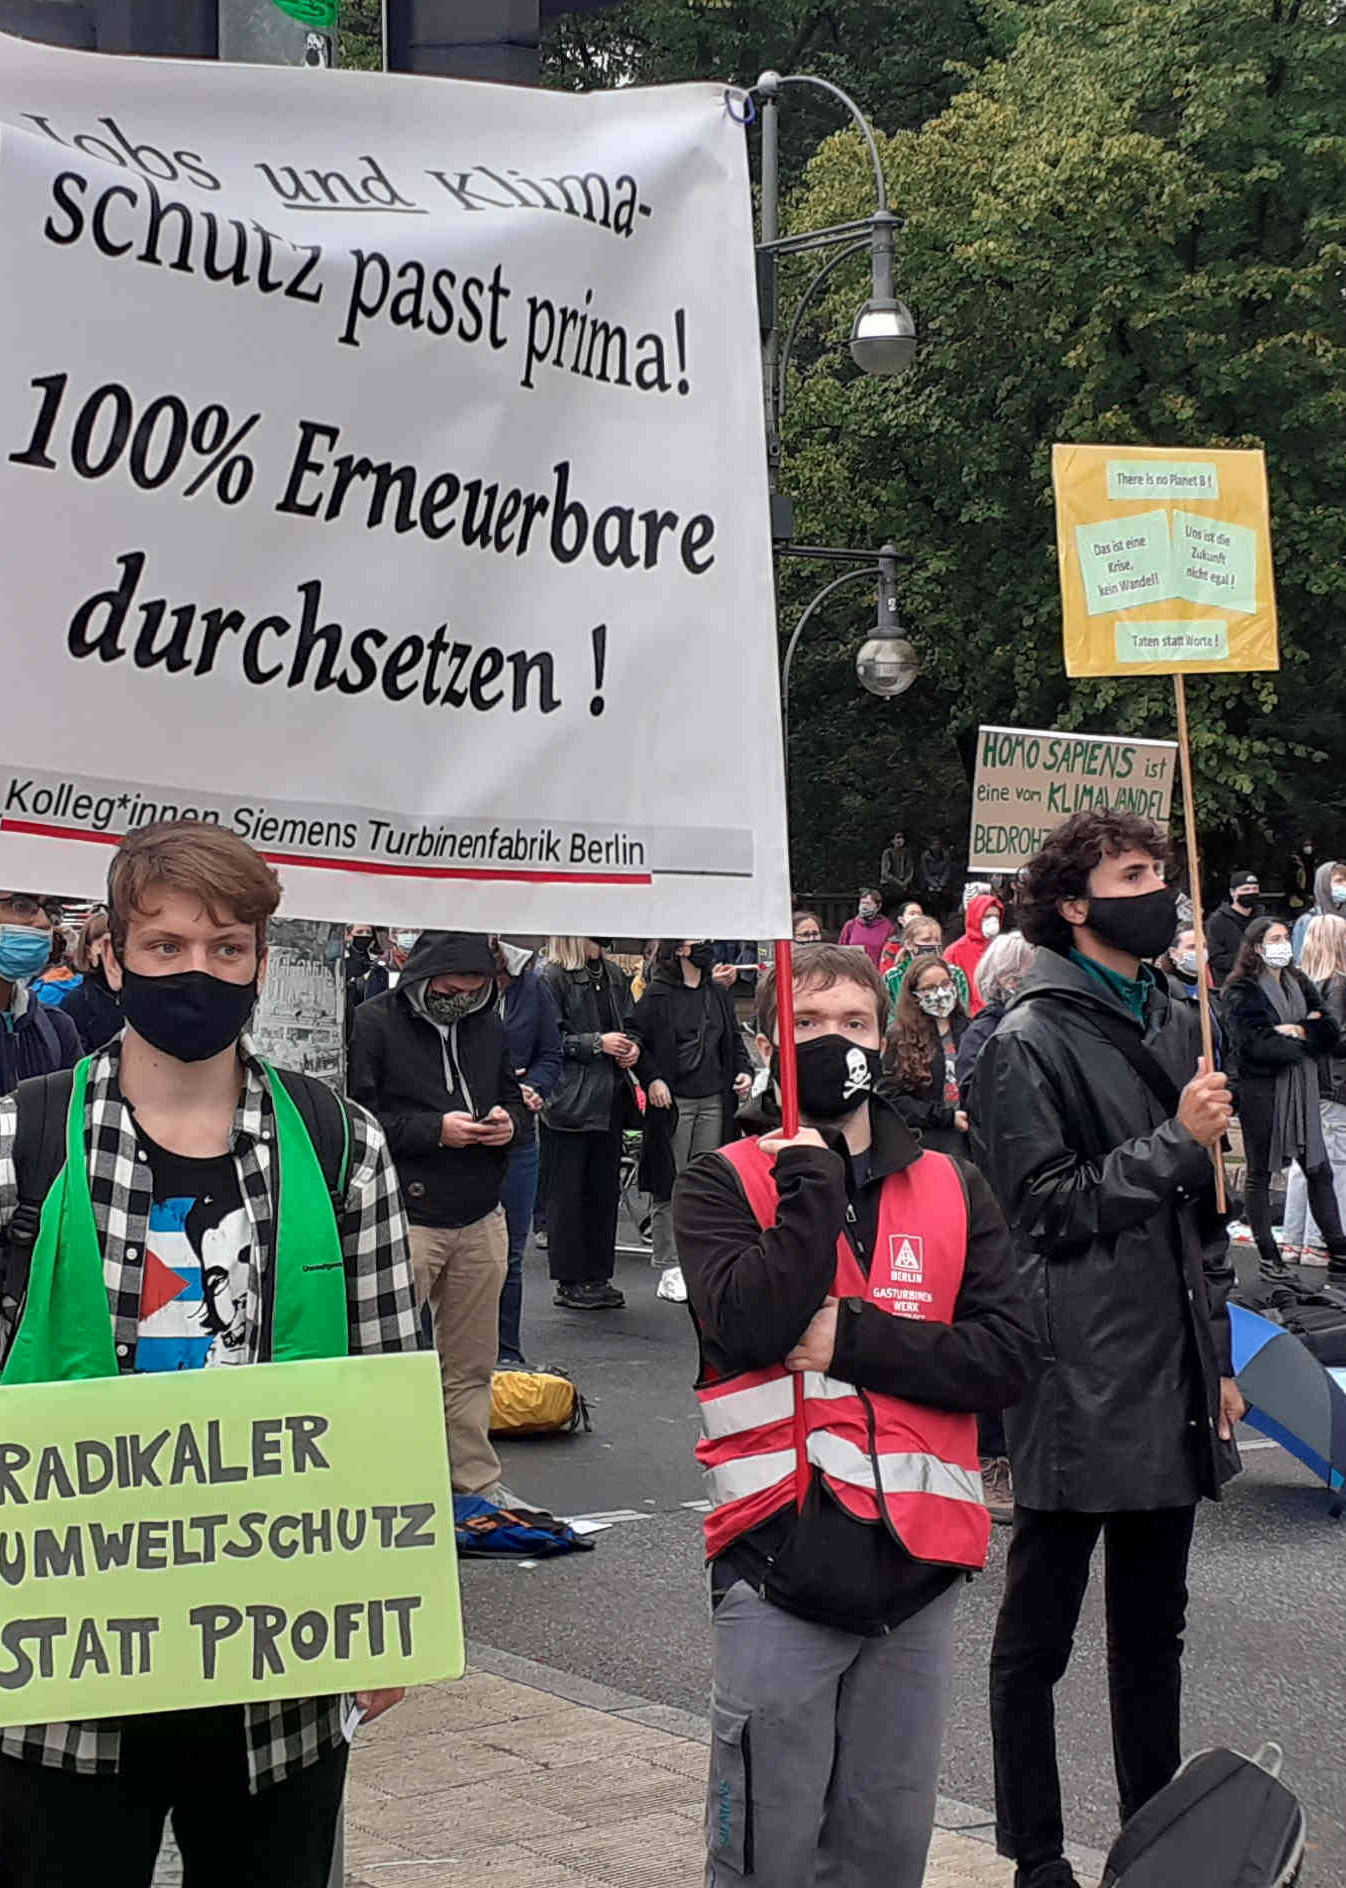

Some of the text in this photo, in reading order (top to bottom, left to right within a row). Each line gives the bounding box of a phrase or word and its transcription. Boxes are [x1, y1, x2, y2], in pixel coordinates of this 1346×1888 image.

[254, 155, 416, 208] und
[426, 166, 652, 238] Klima-
[44, 170, 691, 396] schutz passt prima!
[8, 372, 716, 575] 100% Erneuerbare
[1117, 473, 1143, 486] There
[1146, 474, 1154, 485] is
[1156, 476, 1168, 486] no
[1169, 474, 1197, 487] Planet
[1093, 536, 1147, 556] Das ist eine
[1217, 533, 1231, 546] die
[1191, 546, 1226, 565] Zukunft
[1098, 583, 1118, 597] kein
[67, 550, 610, 718] durchsetzen !
[1132, 634, 1159, 648] Taten
[1162, 634, 1185, 647] statt
[1186, 635, 1214, 648] Worte
[982, 733, 1167, 779] HOMO SAPIENS ist
[977, 784, 1010, 802] eine
[233, 808, 357, 850] Siemens
[366, 820, 561, 864] Turbinenfabrik
[569, 830, 645, 866] Berlin
[891, 1271, 923, 1283] BERLIN
[894, 1301, 919, 1312] WERK
[189, 1595, 422, 1680] PROFIT
